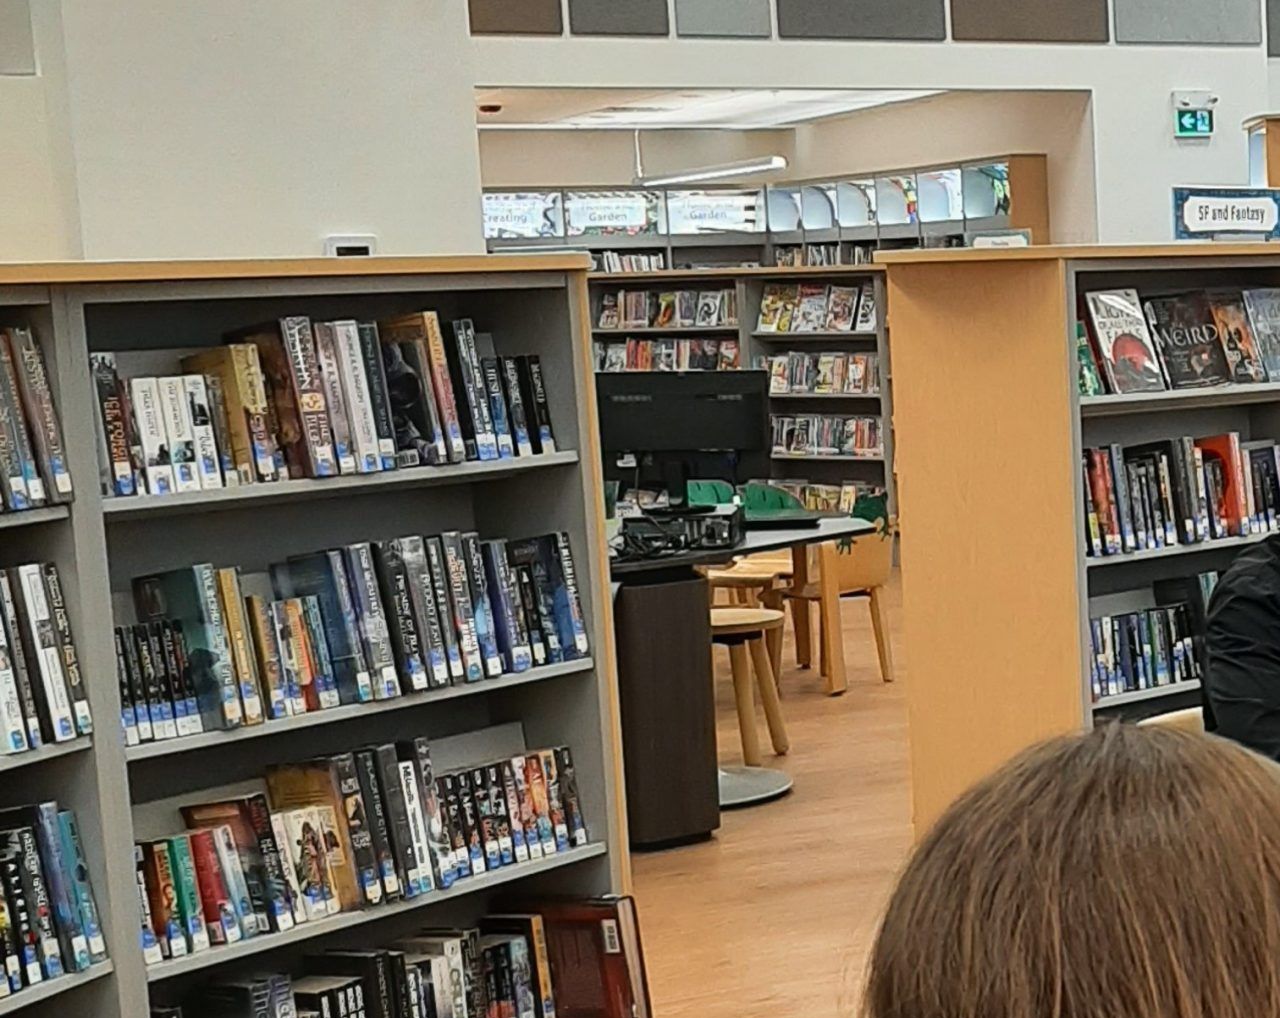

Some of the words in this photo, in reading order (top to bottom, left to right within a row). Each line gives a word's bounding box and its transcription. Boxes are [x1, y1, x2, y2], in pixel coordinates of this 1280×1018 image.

[1198, 205, 1209, 220] SF
[1212, 205, 1228, 220] and
[1231, 204, 1265, 223] Fantasy
[1153, 323, 1219, 348] WEIRD
